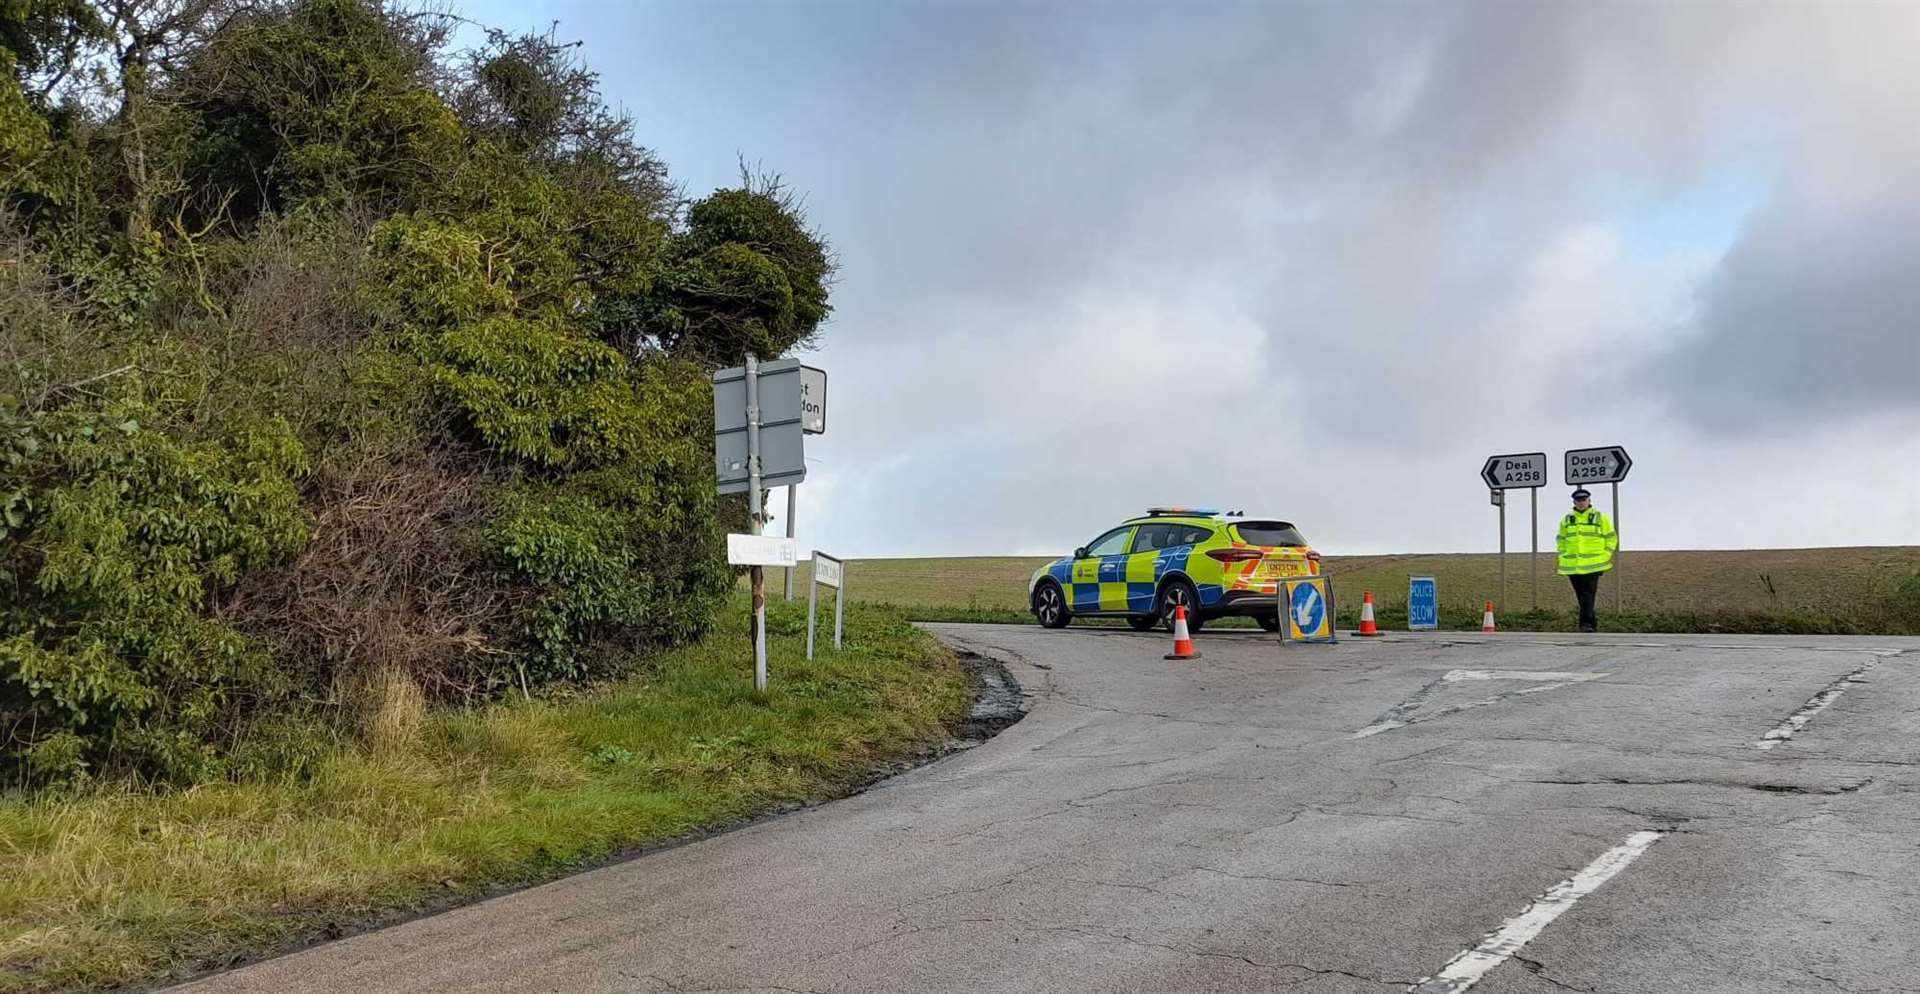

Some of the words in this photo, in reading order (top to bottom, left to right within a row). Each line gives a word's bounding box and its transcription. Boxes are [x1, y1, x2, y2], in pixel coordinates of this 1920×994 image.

[1505, 459, 1532, 470] Deal
[1571, 455, 1606, 466] Dover
[1505, 470, 1540, 482] A258
[1571, 466, 1606, 478] A258
[1411, 605, 1434, 620] SLOW
